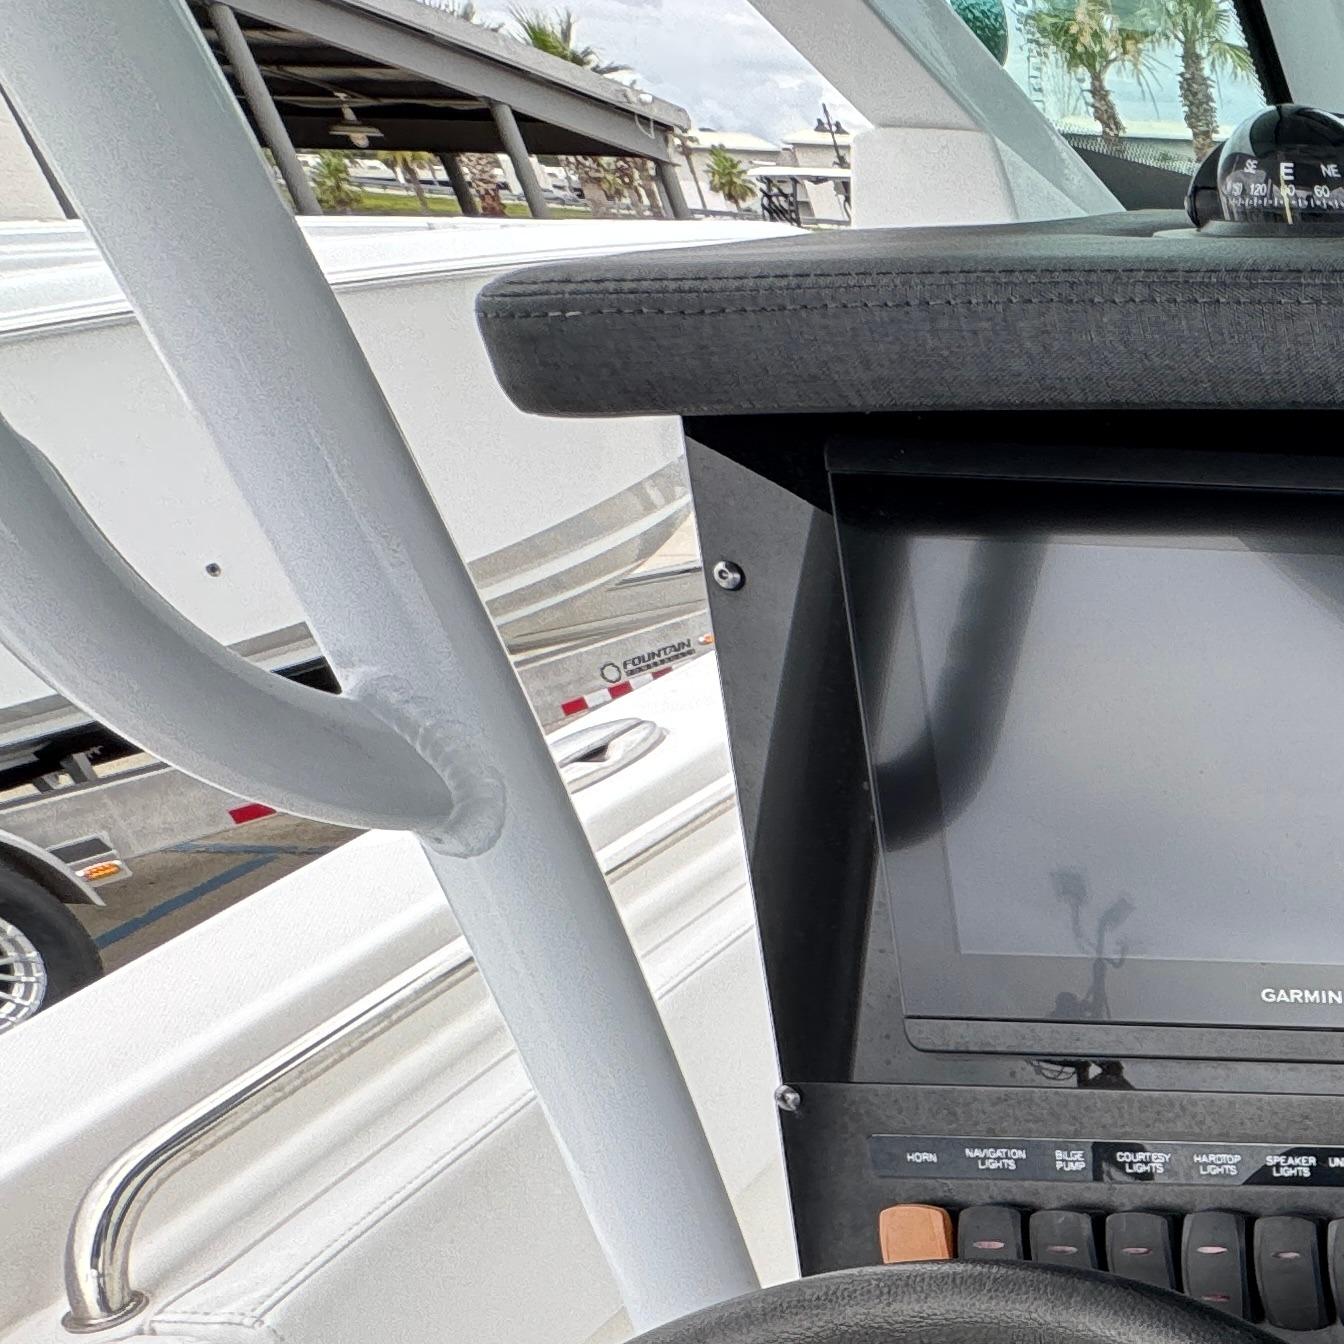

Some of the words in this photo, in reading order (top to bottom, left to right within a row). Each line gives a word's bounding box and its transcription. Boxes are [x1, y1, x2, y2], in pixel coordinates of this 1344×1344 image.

[1280, 162, 1294, 180] E
[1320, 163, 1341, 178] NE
[1250, 183, 1267, 196] 120
[1314, 184, 1330, 198] 60
[623, 638, 691, 669] FOUNTAIN
[1261, 988, 1343, 1005] GARMIN
[907, 1152, 937, 1163] HORN
[965, 1148, 1026, 1159] NAVIGATION
[1055, 1150, 1085, 1161] BILGE
[1116, 1151, 1171, 1163] COURTESY
[1193, 1153, 1241, 1165] HARDTOP
[978, 1159, 1016, 1170] LIGHTS
[1056, 1161, 1085, 1171] PUMP
[1265, 1155, 1317, 1167] SPEAKER
[1125, 1162, 1163, 1173] LIGHTS
[1200, 1164, 1237, 1175] LIGHTS
[1273, 1166, 1311, 1177] LIGHTS
